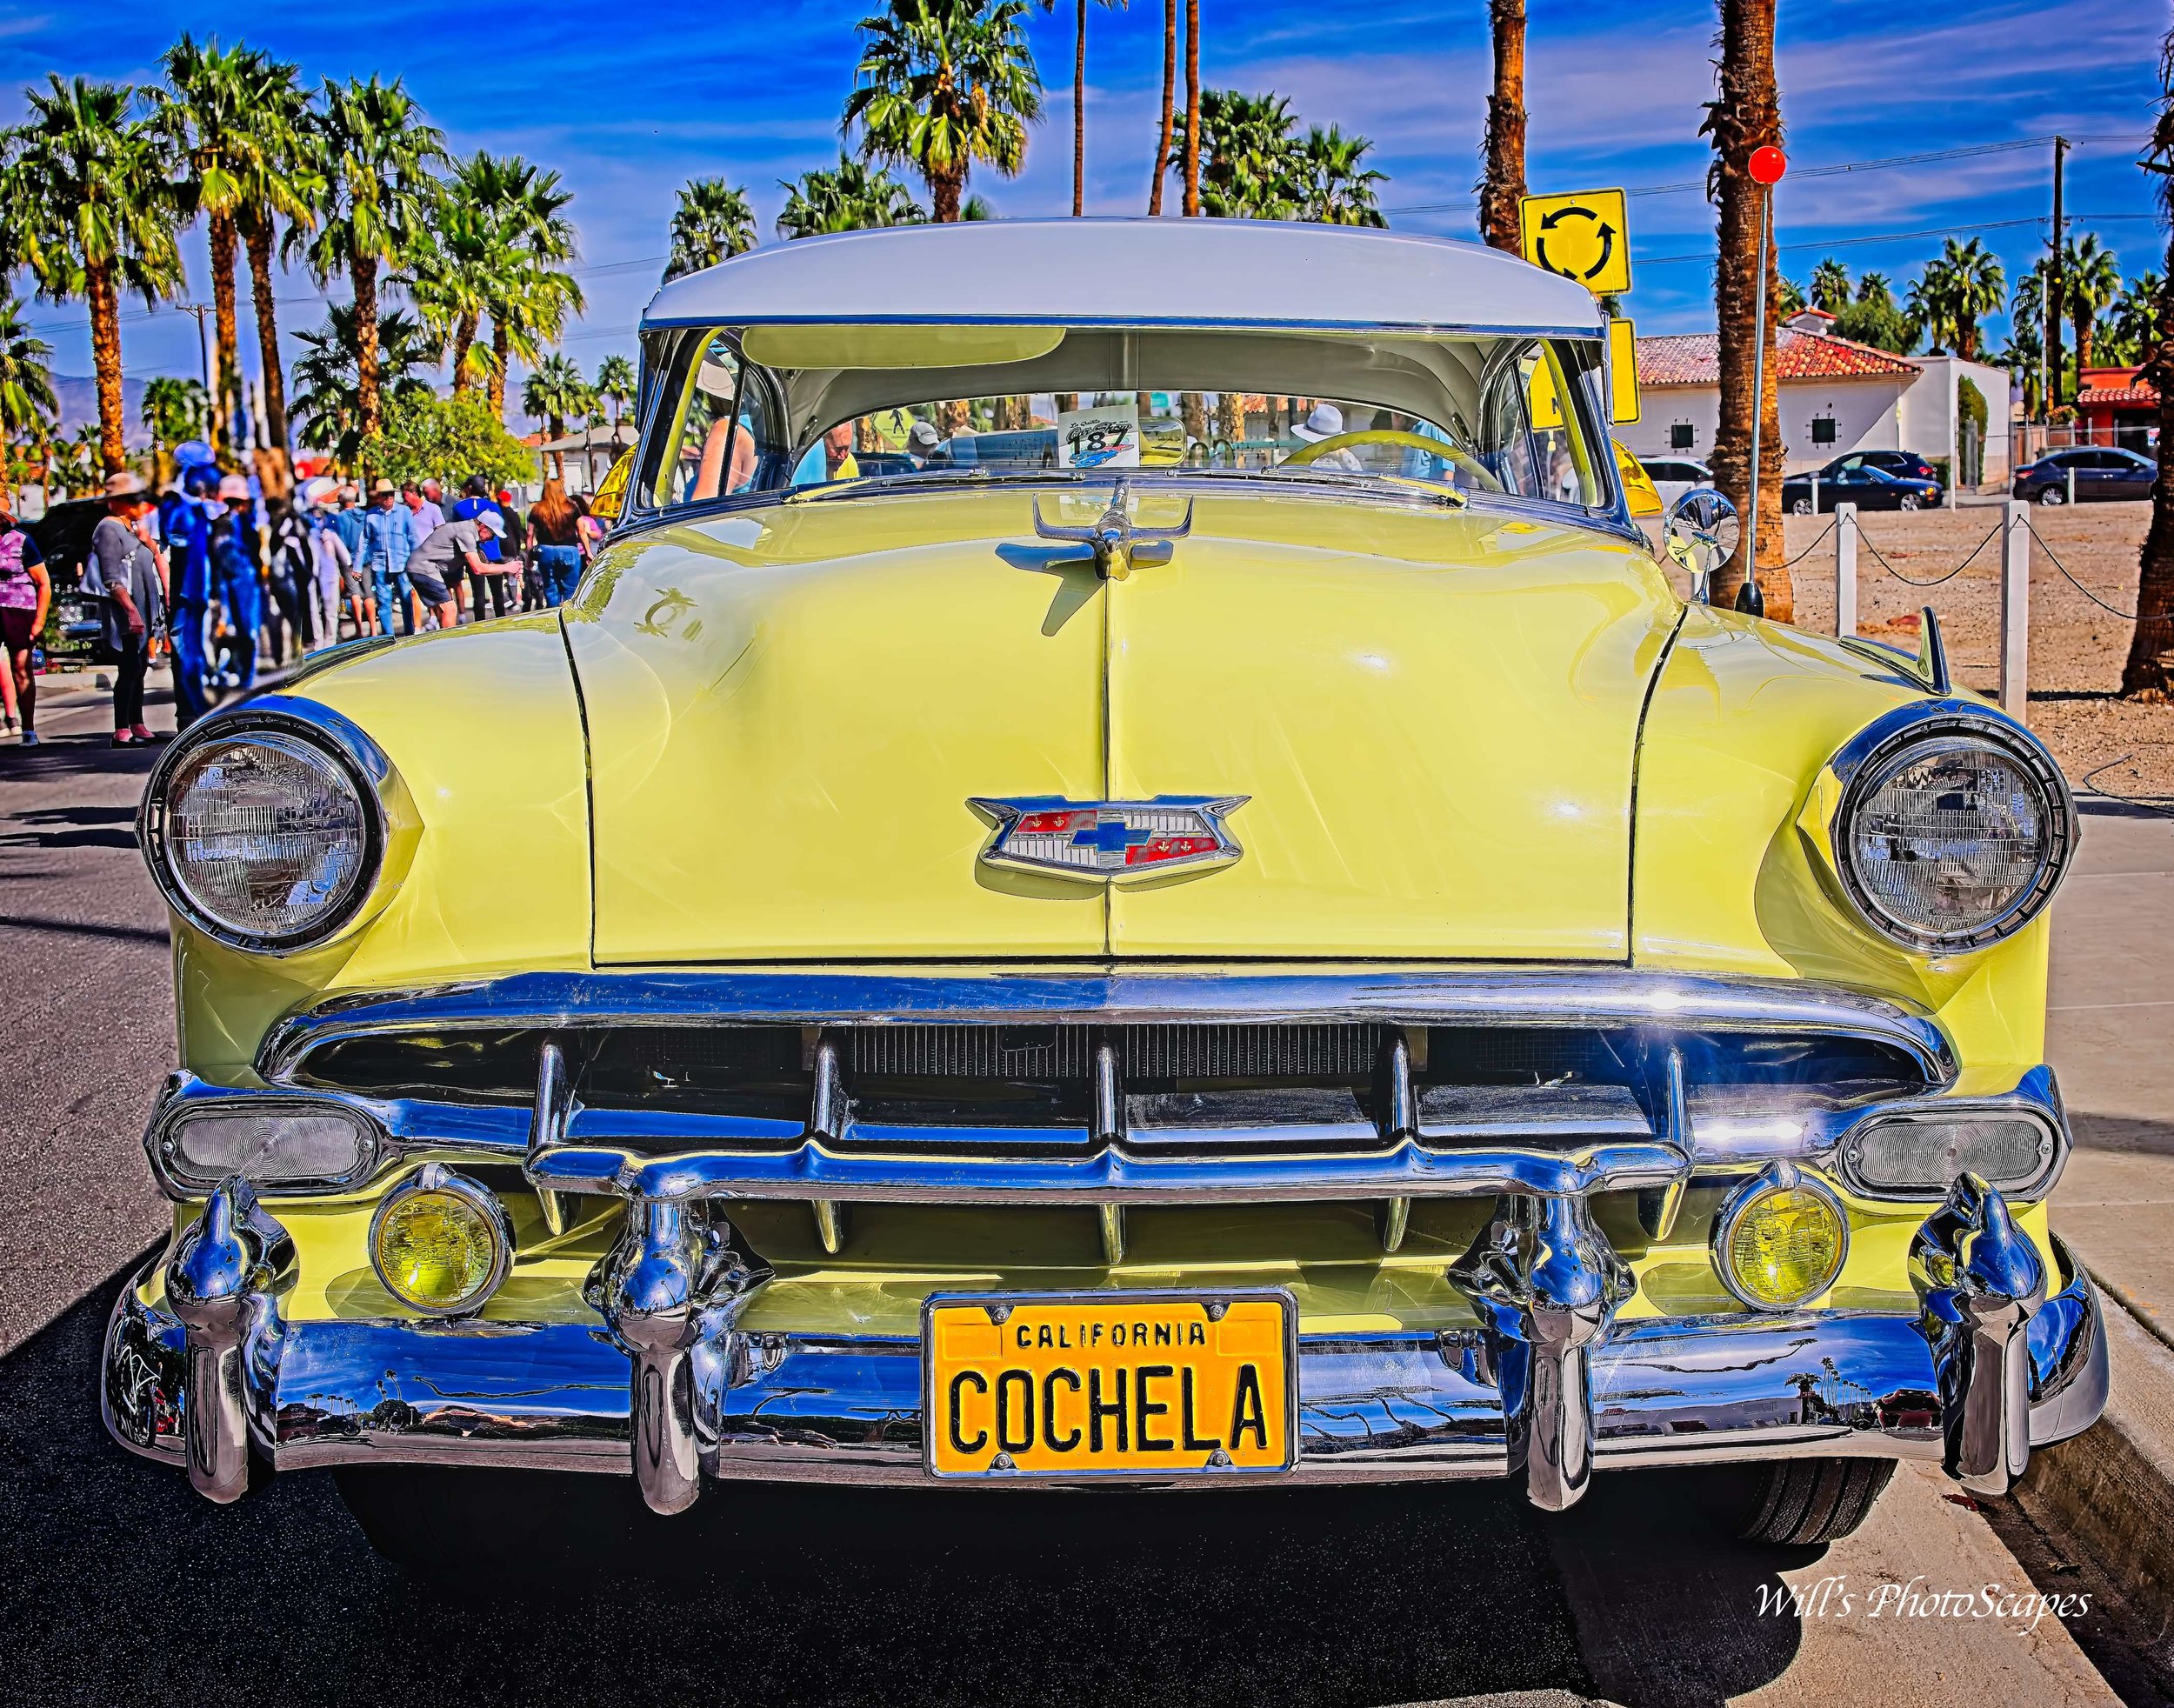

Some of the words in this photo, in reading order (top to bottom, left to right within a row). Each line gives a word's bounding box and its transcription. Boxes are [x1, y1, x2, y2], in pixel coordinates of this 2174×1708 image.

[1067, 424, 1132, 455] 187
[1017, 1322, 1206, 1349] CALIFORNIA
[950, 1363, 1268, 1455] COCHELA
